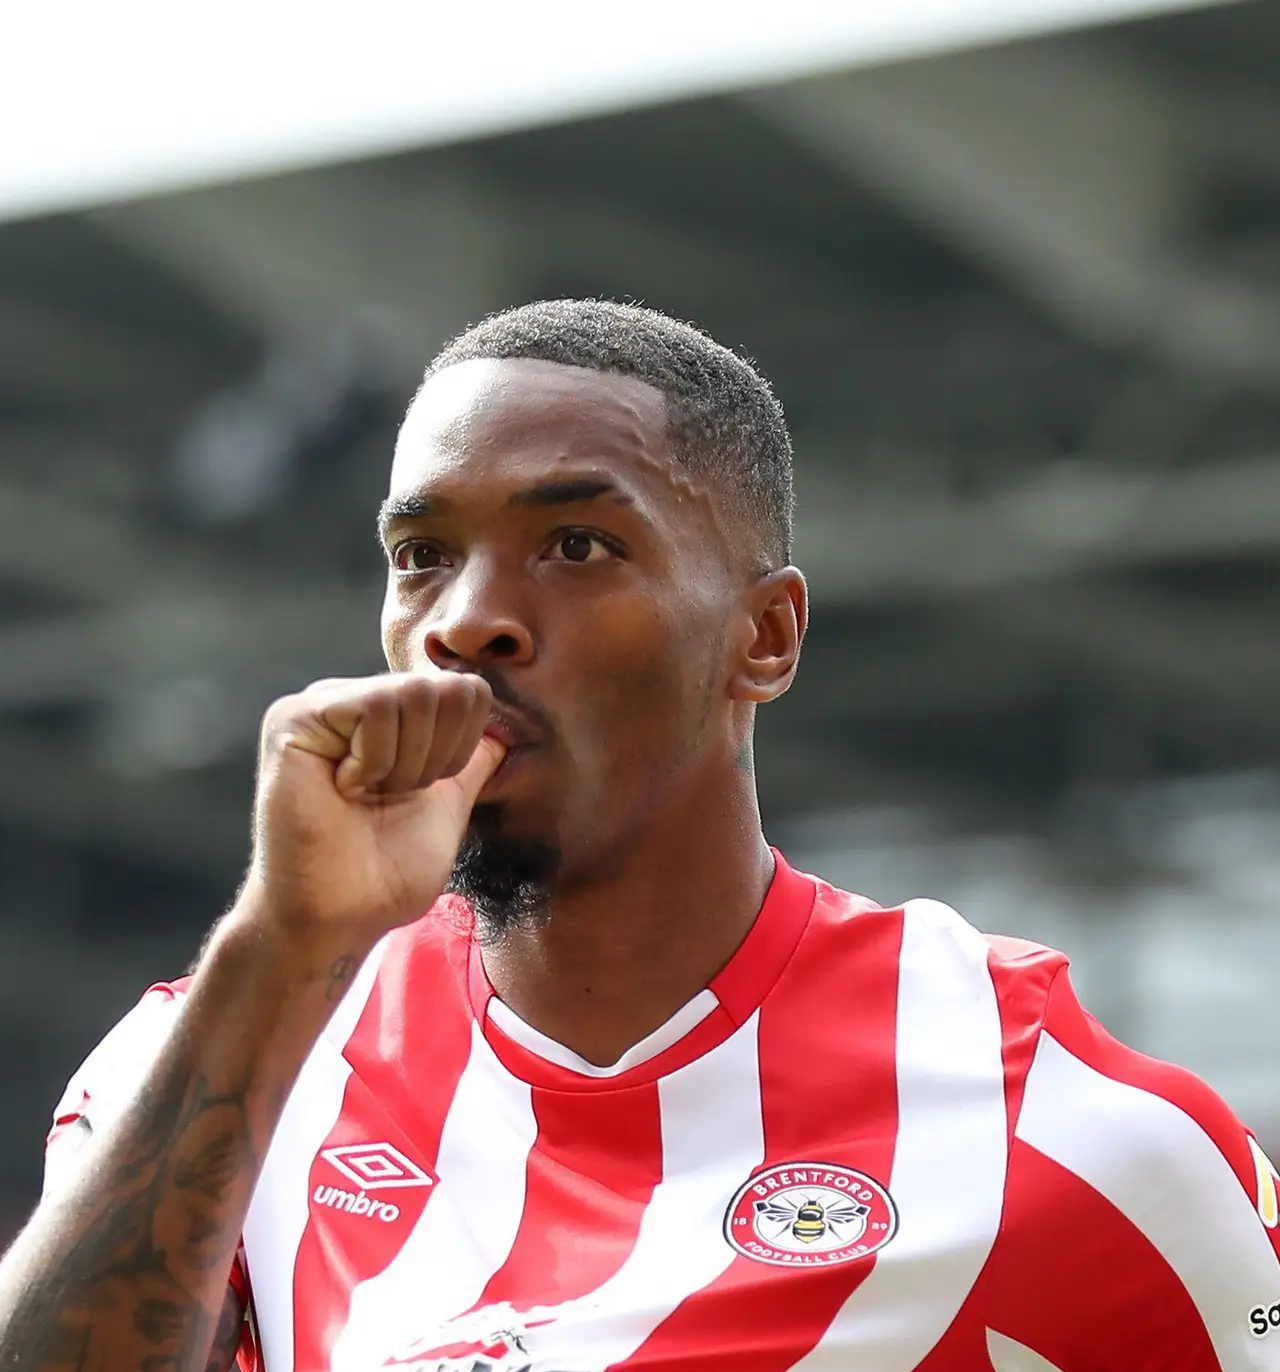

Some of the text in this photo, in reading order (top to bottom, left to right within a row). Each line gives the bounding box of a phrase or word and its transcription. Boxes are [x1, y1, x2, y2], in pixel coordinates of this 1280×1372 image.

[753, 1171, 873, 1201] BRENTFORD
[314, 1185, 400, 1222] umbro
[733, 1217, 747, 1226] 18
[744, 1241, 823, 1263] FOOTBALL
